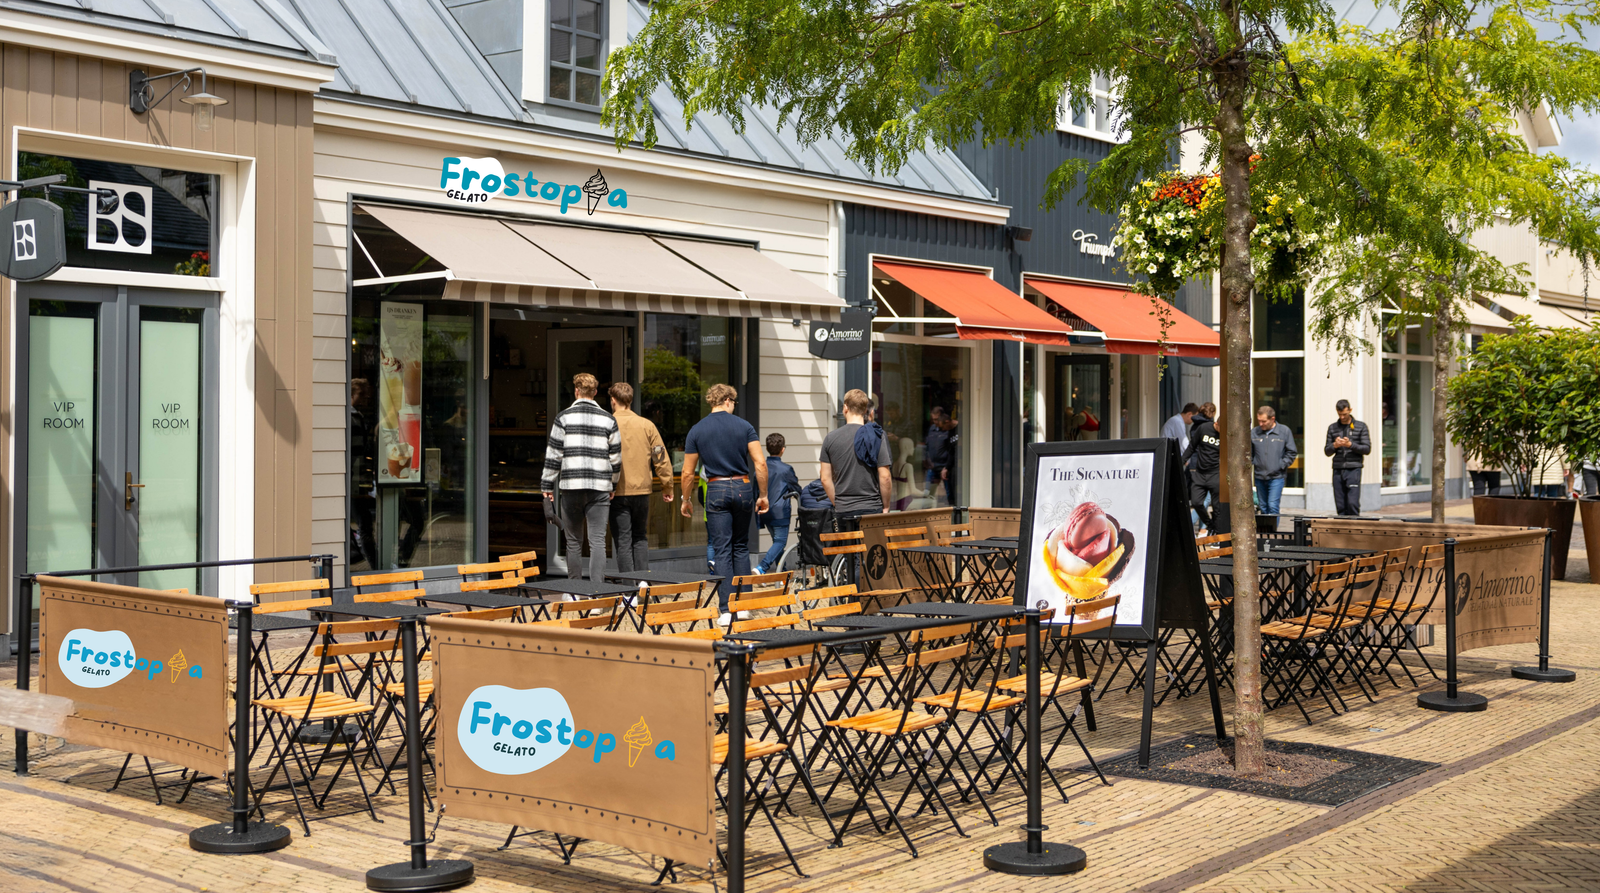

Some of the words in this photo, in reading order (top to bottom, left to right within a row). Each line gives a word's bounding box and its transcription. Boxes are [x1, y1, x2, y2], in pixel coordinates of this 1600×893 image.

[446, 189, 488, 203] GELATO
[829, 328, 863, 338] Amorino
[53, 402, 75, 412] VIP
[161, 403, 181, 413] VIP
[43, 418, 84, 429] ROOM
[152, 419, 189, 429] ROOM
[1050, 467, 1074, 481] THE
[1076, 467, 1140, 481] SIGNATURE
[1469, 568, 1535, 601] Amorino
[81, 665, 111, 676] GELATO
[493, 741, 536, 757] GELATO
